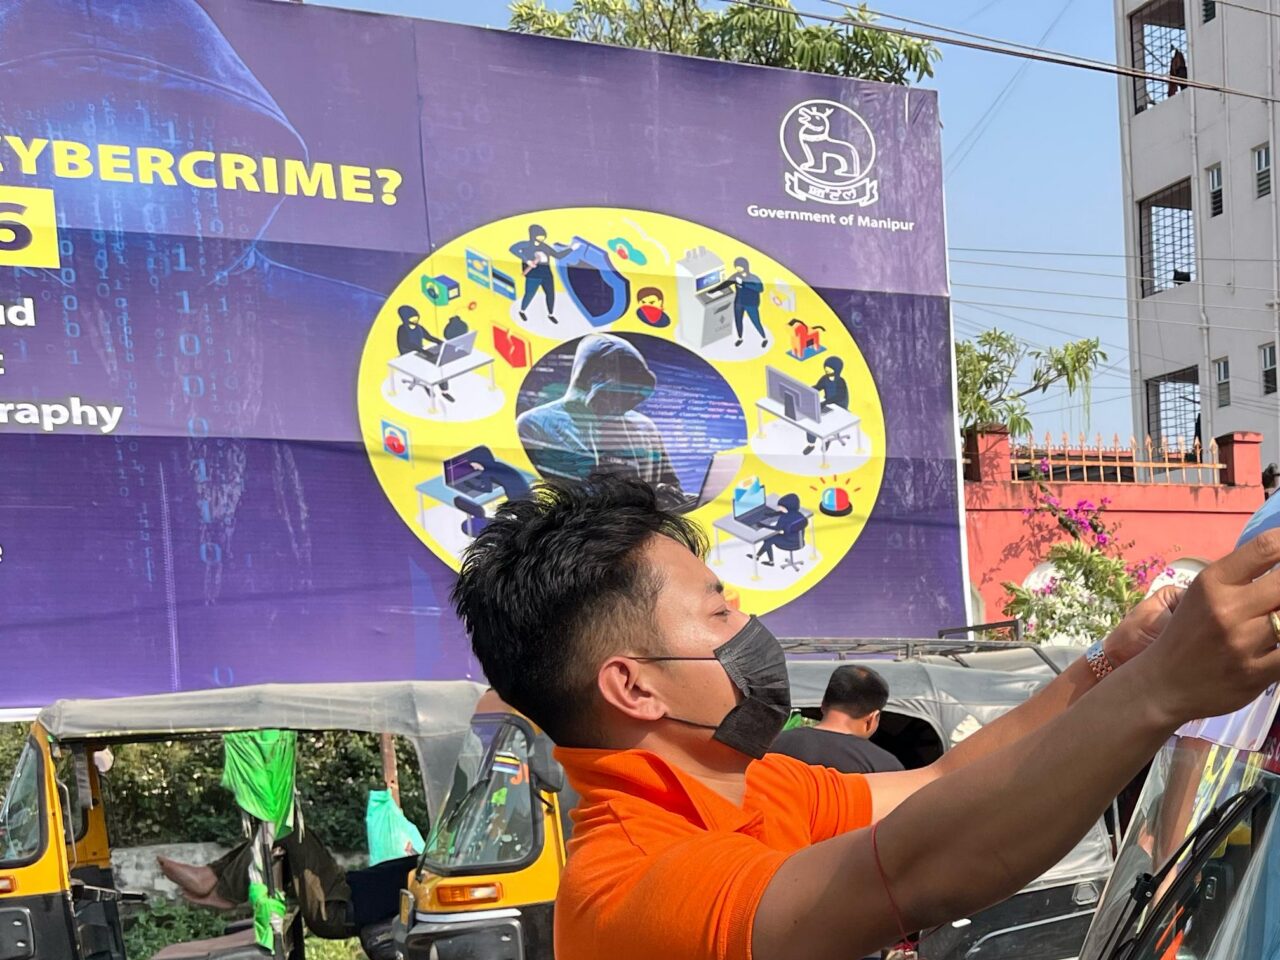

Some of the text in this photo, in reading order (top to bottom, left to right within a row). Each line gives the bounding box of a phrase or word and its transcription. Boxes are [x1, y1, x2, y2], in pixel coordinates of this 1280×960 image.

[0, 135, 403, 206] YBERCRIME?
[747, 204, 915, 232] Government of Manipur
